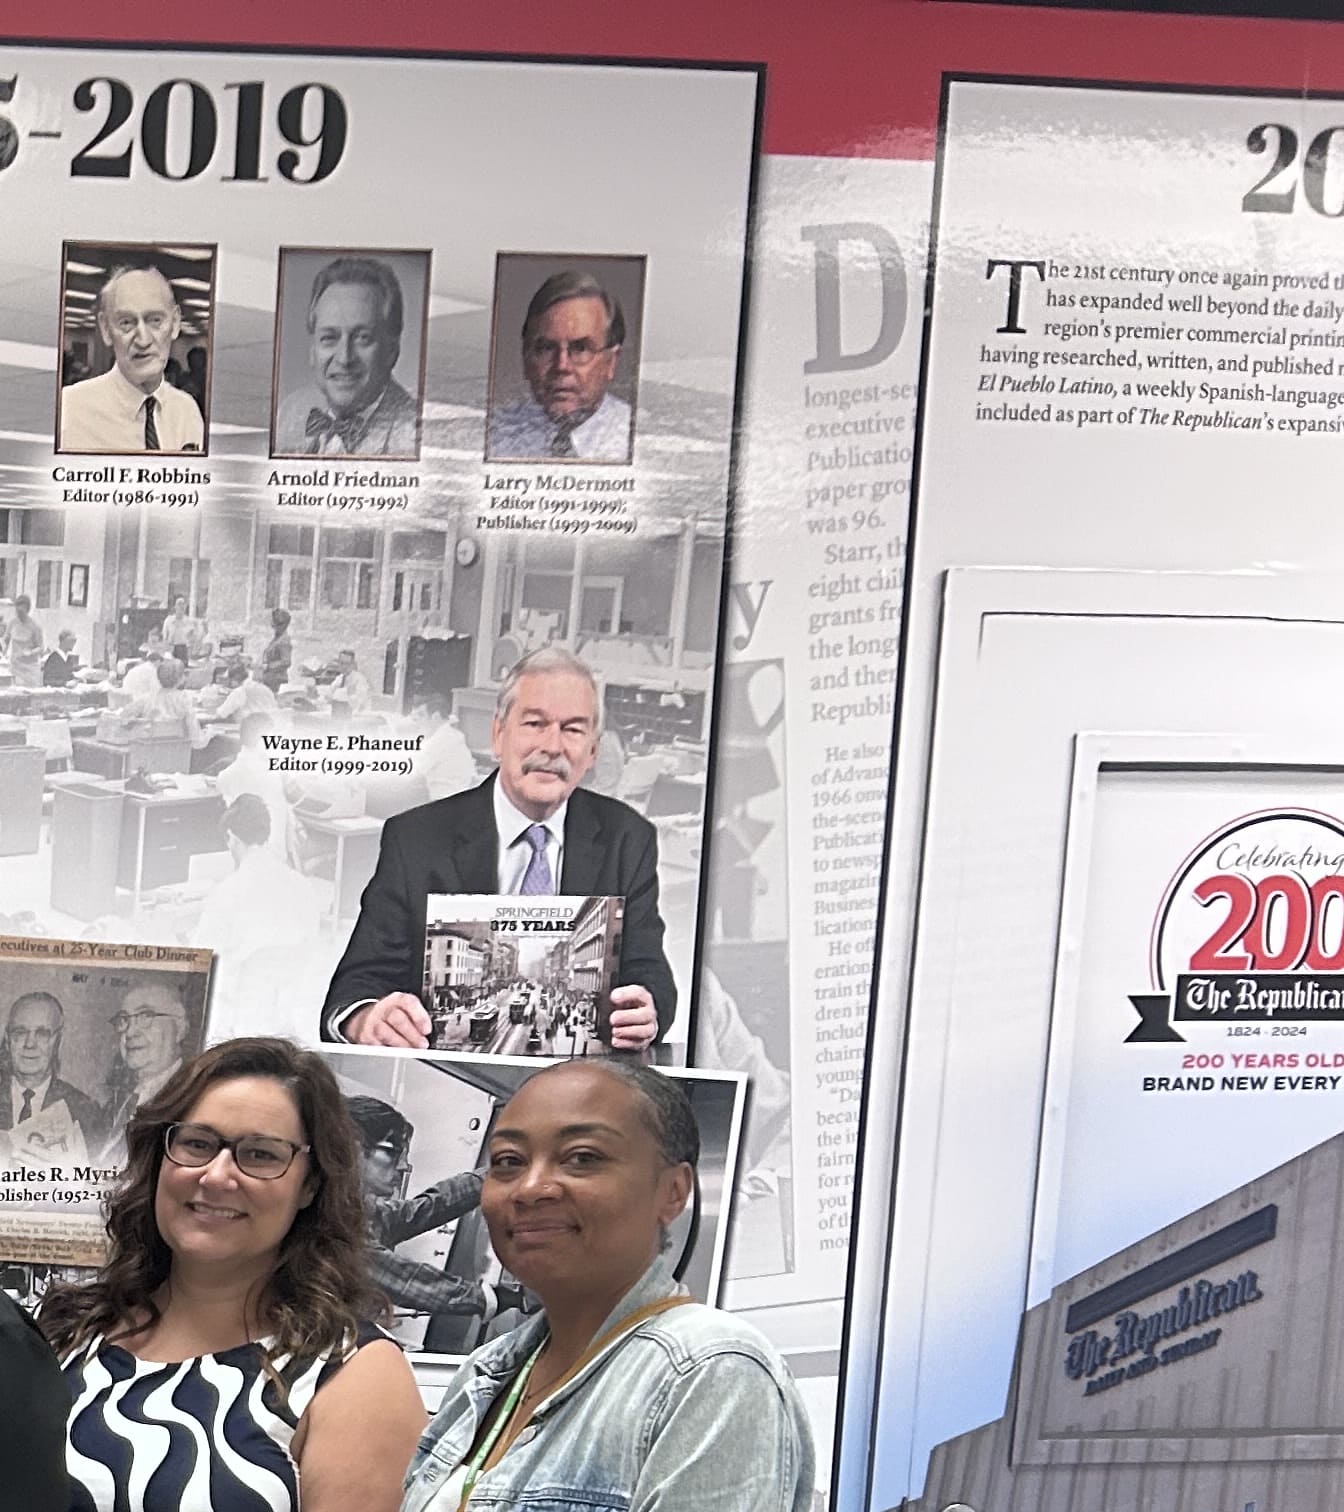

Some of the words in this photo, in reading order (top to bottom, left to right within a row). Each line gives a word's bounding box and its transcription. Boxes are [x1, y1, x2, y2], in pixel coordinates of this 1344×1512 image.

[1074, 265, 1106, 280] 21st
[1109, 265, 1175, 289] century
[1178, 270, 1219, 285] once
[1222, 268, 1269, 291] again
[1272, 272, 1330, 293] proved
[1046, 289, 1076, 308] has
[1080, 292, 1164, 314] expanded
[1168, 294, 1203, 313] well
[1207, 295, 1269, 319] beyond
[1273, 299, 1300, 318] the
[1044, 318, 1112, 341] region's
[1115, 322, 1184, 343] premier
[1187, 326, 1287, 345] commercial
[979, 344, 1039, 369] having
[1043, 348, 1143, 371] researched,
[1147, 350, 1213, 373] written,
[1217, 354, 1249, 372] and
[1252, 355, 1335, 378] published
[977, 374, 997, 392] El
[999, 374, 1055, 393] Pueblo
[1058, 376, 1118, 399] Latino,
[1136, 379, 1196, 404] weekly
[805, 414, 905, 439] executive
[976, 402, 1052, 422] included
[1055, 410, 1074, 423] as
[1077, 409, 1113, 428] part
[1116, 406, 1138, 424] of
[1139, 407, 1169, 426] The
[1172, 409, 1274, 432] Republican's
[52, 466, 115, 484] Carroll
[119, 467, 134, 484] F.
[137, 468, 211, 485] Robbins
[267, 470, 330, 487] Arnold
[333, 470, 421, 488] Friedman
[483, 474, 533, 495] Larry
[535, 475, 636, 492] McDermott
[62, 488, 111, 503] Editor
[113, 489, 200, 507] (1986-1991)
[277, 492, 325, 506] Editor
[326, 492, 410, 511] (1975-1992)
[489, 496, 536, 510] Editor
[806, 484, 866, 509] paper
[476, 515, 547, 530] Publisher
[806, 516, 849, 535] was
[823, 542, 883, 566] Starr,
[808, 575, 862, 601] eight
[808, 605, 875, 634] grants
[809, 639, 844, 660] the
[810, 666, 849, 691] and
[261, 735, 323, 755] Wayne
[326, 735, 344, 751] E.
[347, 735, 425, 751] Phaneuf
[268, 757, 319, 772] Editor
[320, 758, 414, 776] (1999-2019)
[495, 907, 574, 918] SPRINGFIELD
[521, 920, 577, 932] YEARS
[69, 943, 117, 958] 25-Year
[124, 944, 153, 959] Club
[156, 947, 199, 962] Dinner
[1187, 978, 1231, 1015] The
[1226, 1026, 1261, 1037] 1824
[1271, 1026, 1308, 1037] 2024
[1182, 1054, 1224, 1069] 200
[1230, 1054, 1300, 1069] YEARS
[1143, 1076, 1216, 1092] BRAND
[1220, 1076, 1269, 1091] NEW
[1273, 1075, 1342, 1090] EVERY
[50, 1167, 69, 1183] R.
